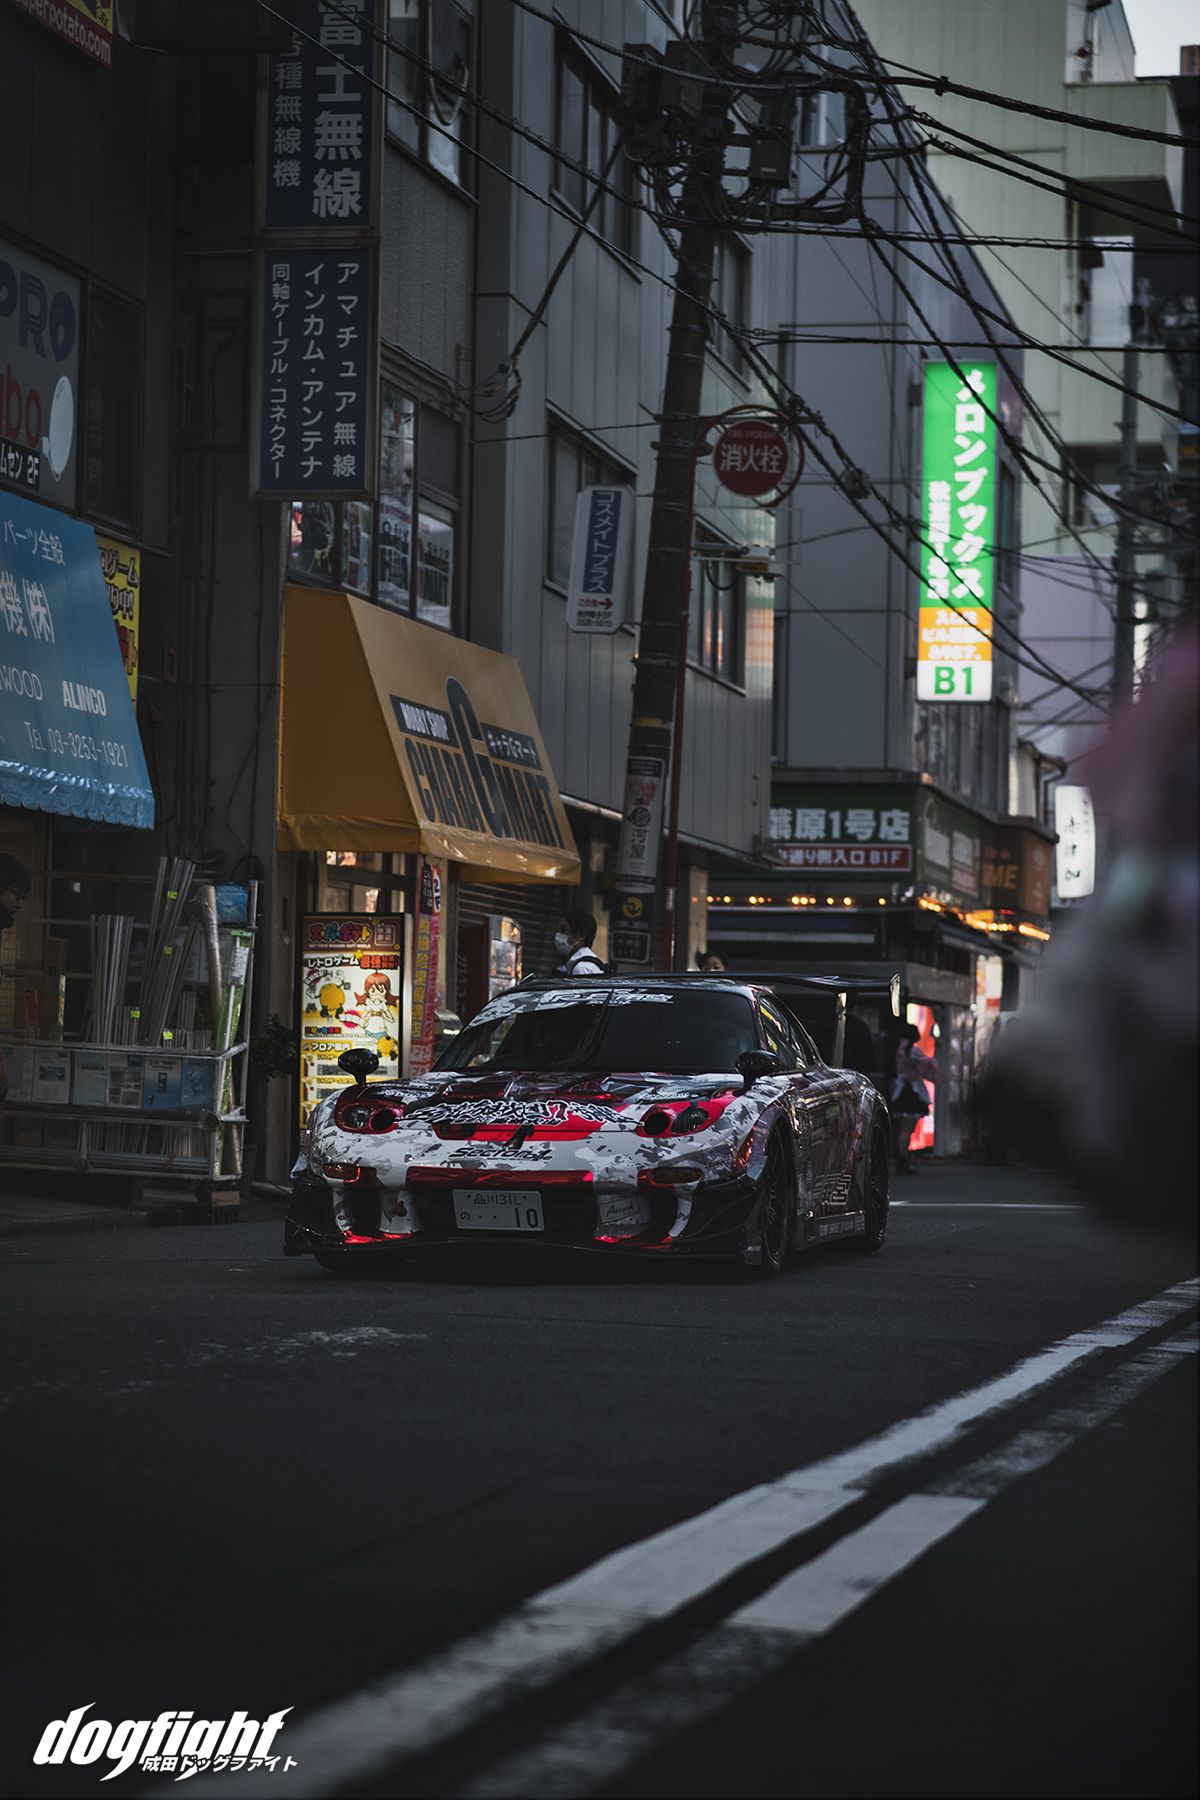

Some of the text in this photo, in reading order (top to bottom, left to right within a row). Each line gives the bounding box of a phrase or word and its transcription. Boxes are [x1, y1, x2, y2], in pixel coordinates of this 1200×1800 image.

[312, 0, 364, 218] 富士無線
[269, 263, 291, 480] 同軸ケーブル・コネクター
[299, 262, 326, 479] インカム・アンテナ
[332, 262, 361, 478] アマチュア無線
[0, 362, 42, 449] bo
[26, 453, 41, 488] 2F
[719, 442, 784, 474] 消火栓
[951, 367, 989, 601] メロンブックス
[3, 518, 67, 566] パーツ全般
[588, 491, 616, 593] コスメイトプラス
[61, 679, 108, 718] ALINCO
[934, 665, 973, 695] B1
[47, 726, 130, 768] 03-3253-1921
[869, 849, 903, 865] B1F
[307, 954, 360, 968] レトロゲーム
[459, 1211, 471, 1222] の
